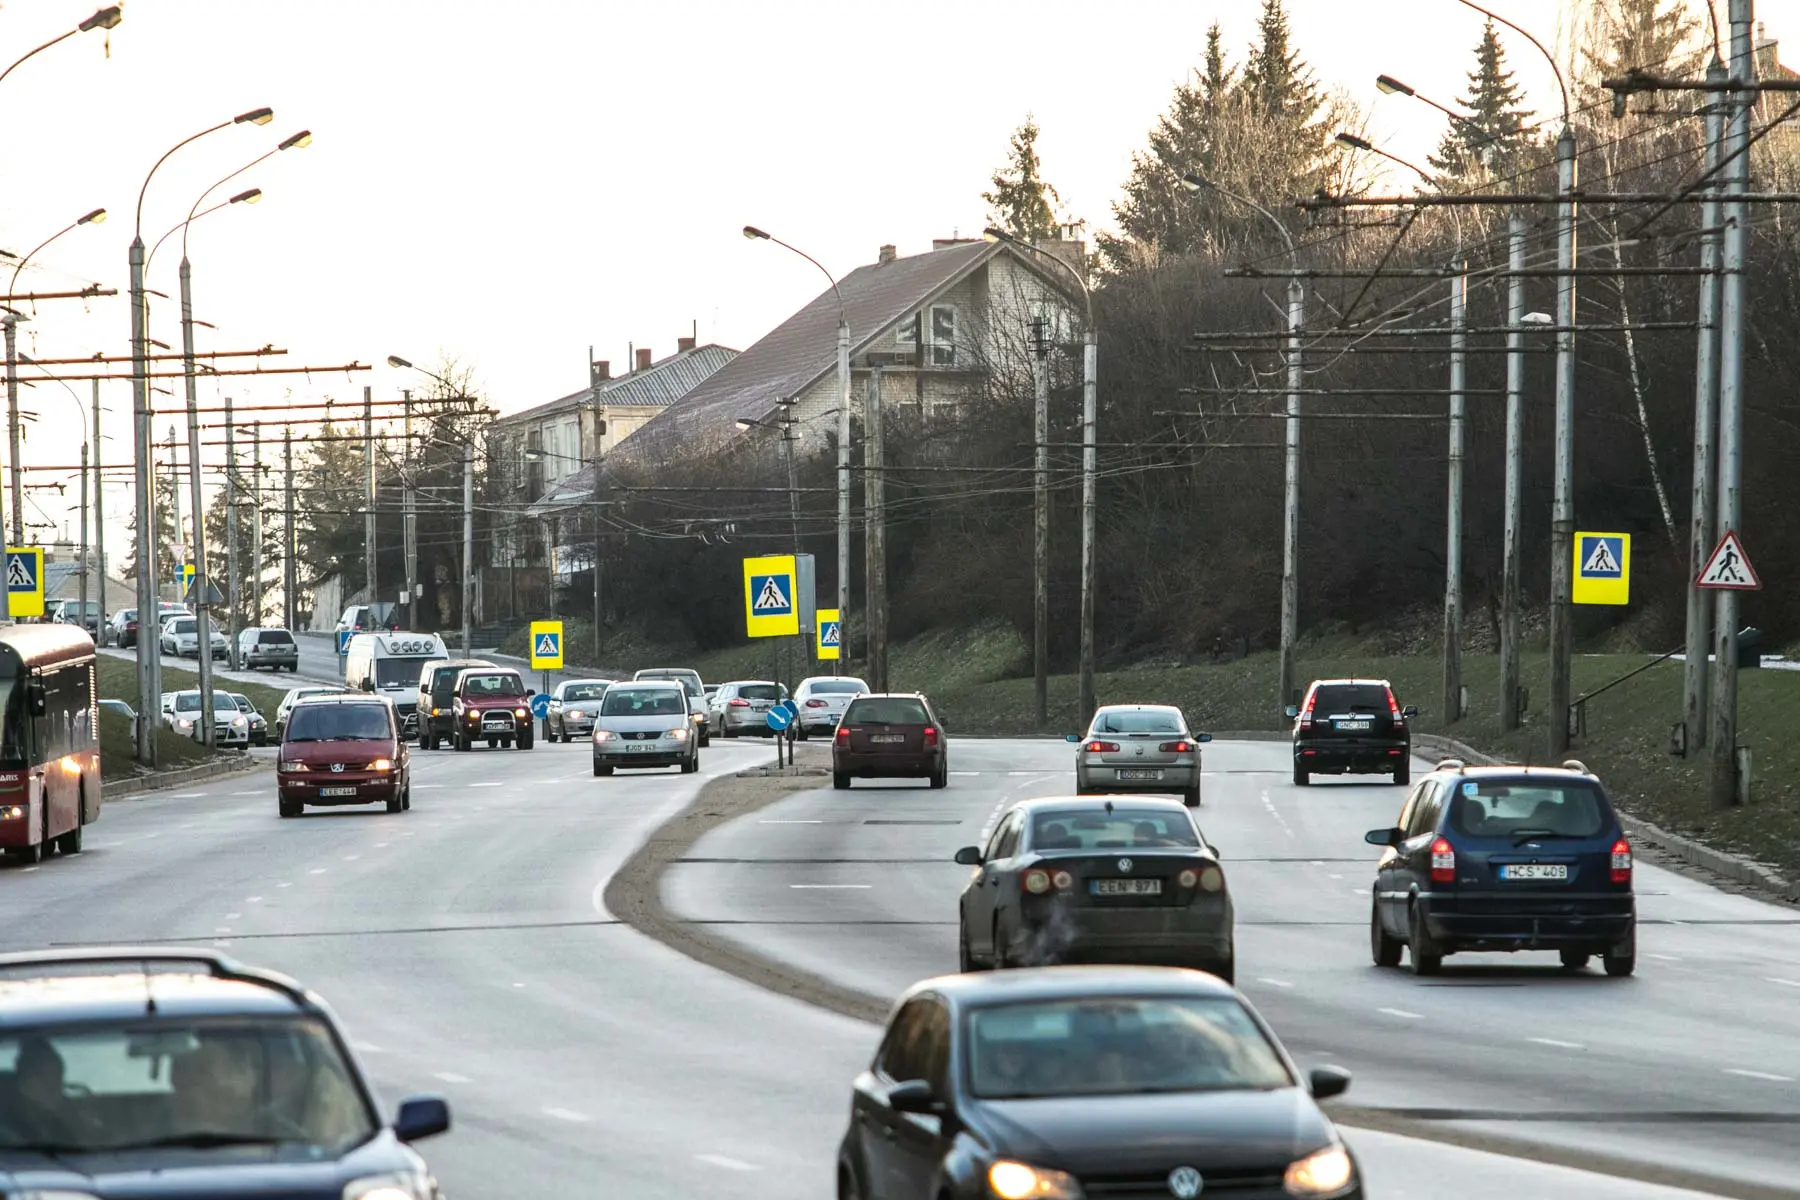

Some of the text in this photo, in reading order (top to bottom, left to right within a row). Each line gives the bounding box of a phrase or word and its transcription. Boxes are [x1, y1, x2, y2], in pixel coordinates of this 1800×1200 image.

[1508, 866, 1566, 878] HCS 409
[1099, 880, 1158, 892] EEN 971
